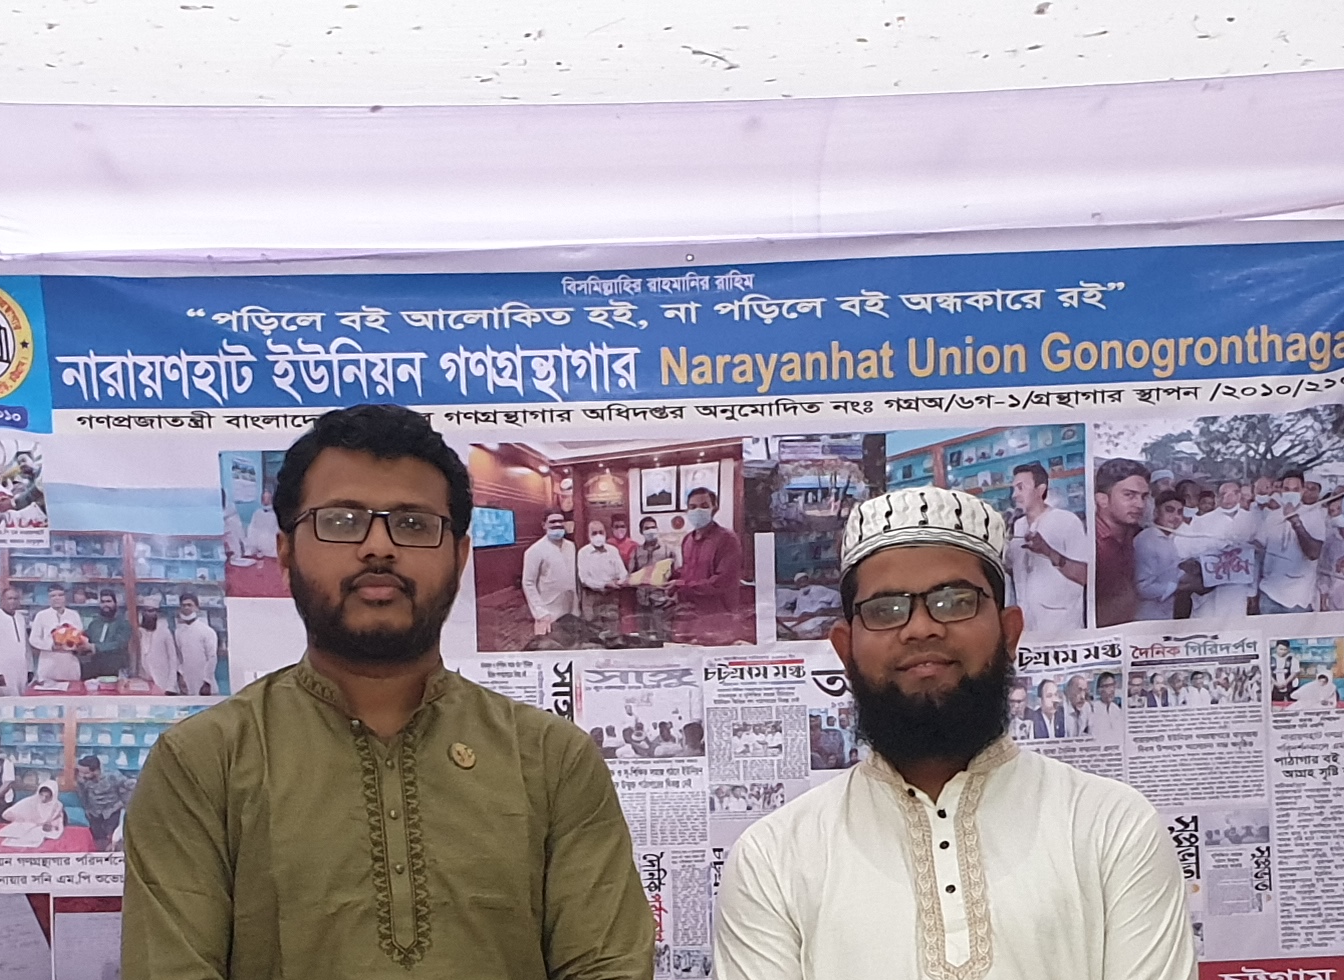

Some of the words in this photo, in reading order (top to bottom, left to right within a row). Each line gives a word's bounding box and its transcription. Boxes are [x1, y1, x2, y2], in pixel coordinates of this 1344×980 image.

[716, 270, 754, 291] রাহিম
[340, 306, 392, 334] বই
[401, 302, 575, 333] আলোকিত
[660, 301, 700, 326] না
[713, 293, 826, 325] পড়িলে
[835, 288, 891, 319] বই
[898, 286, 1045, 315] অন্ধকারে
[55, 340, 258, 406] নারায়ণহাট
[265, 336, 428, 405] ইউনিয়ন
[439, 341, 642, 402] গণগ্রন্থাগার
[660, 341, 894, 392] Narayanhat
[907, 336, 1027, 378] Union
[224, 409, 318, 430] বাংলাদে
